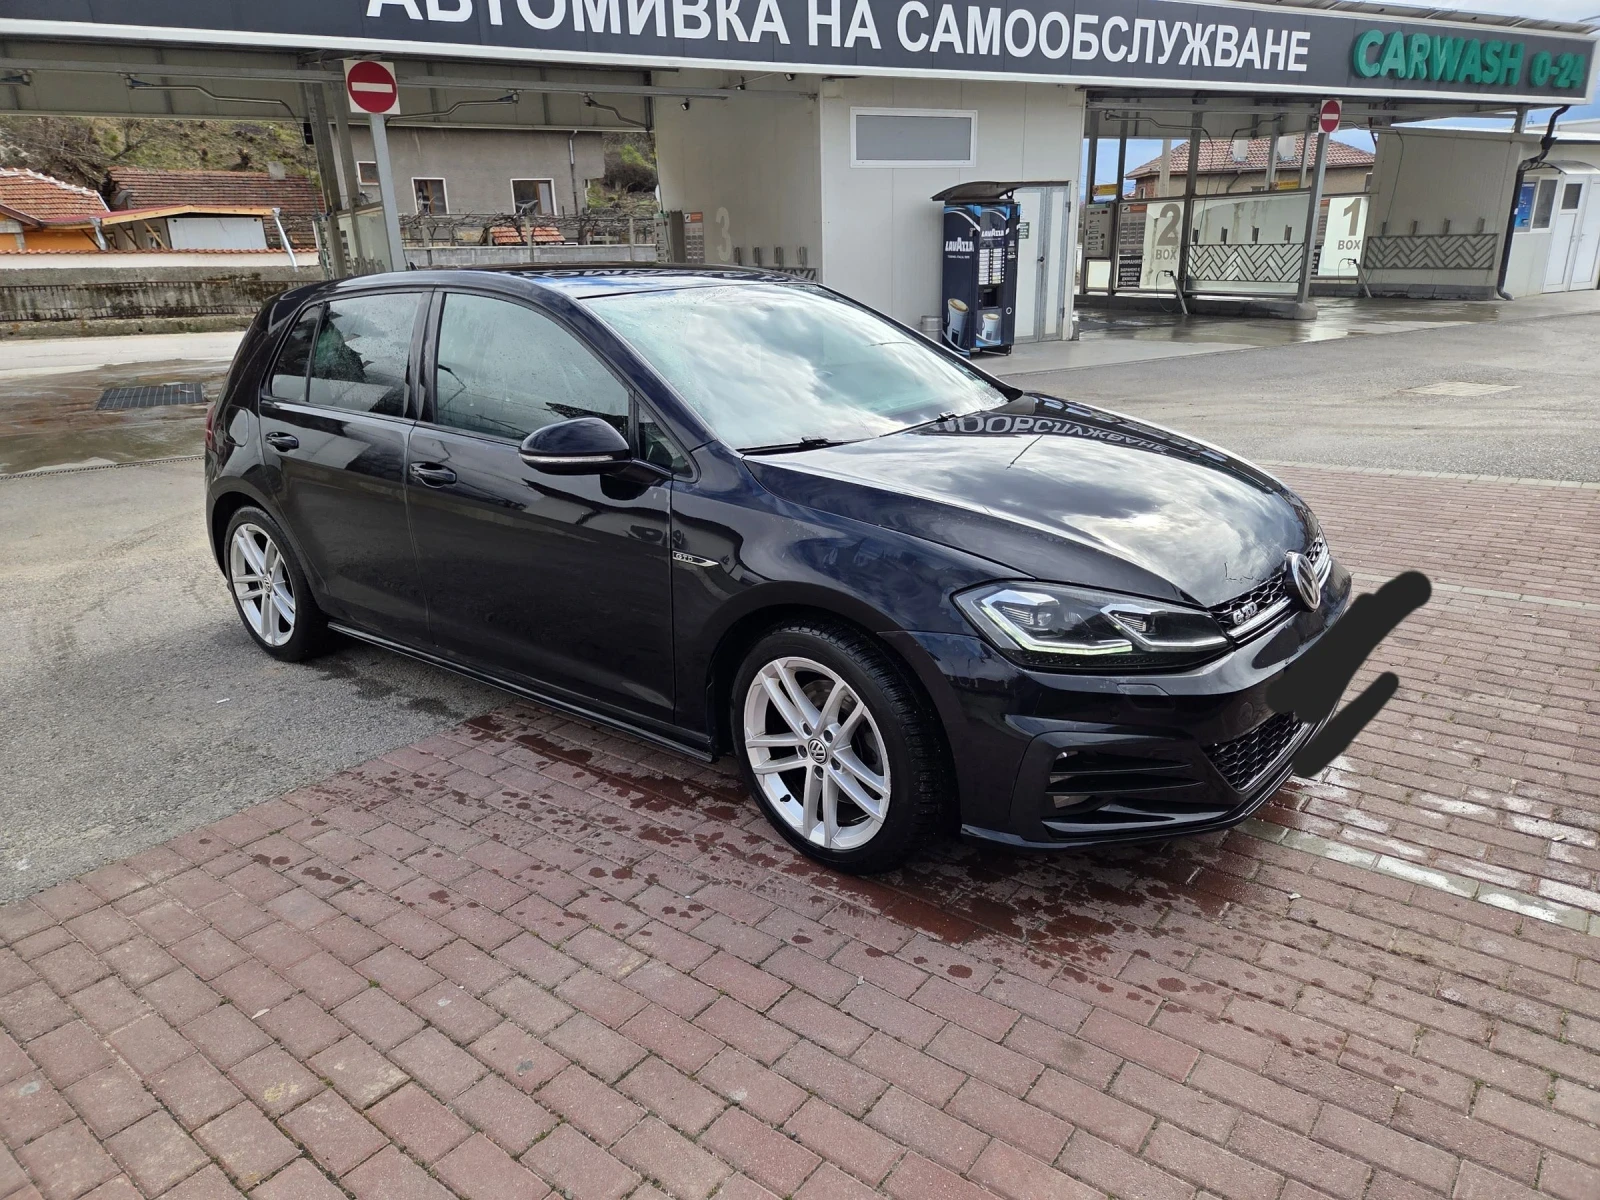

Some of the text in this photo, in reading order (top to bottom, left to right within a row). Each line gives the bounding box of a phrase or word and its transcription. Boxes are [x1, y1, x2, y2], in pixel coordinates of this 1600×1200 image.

[366, 0, 1311, 73] ОМИВКА НА САМООБСЛУЖВАНЕ
[1353, 29, 1586, 89] CARWASH 0-24
[715, 206, 732, 263] 3
[1156, 203, 1181, 247] 2
[1343, 198, 1362, 237] 1
[945, 237, 974, 252] LAVAZZA
[1155, 249, 1177, 260] BOX
[1337, 240, 1361, 251] BOX
[675, 552, 693, 563] GTD
